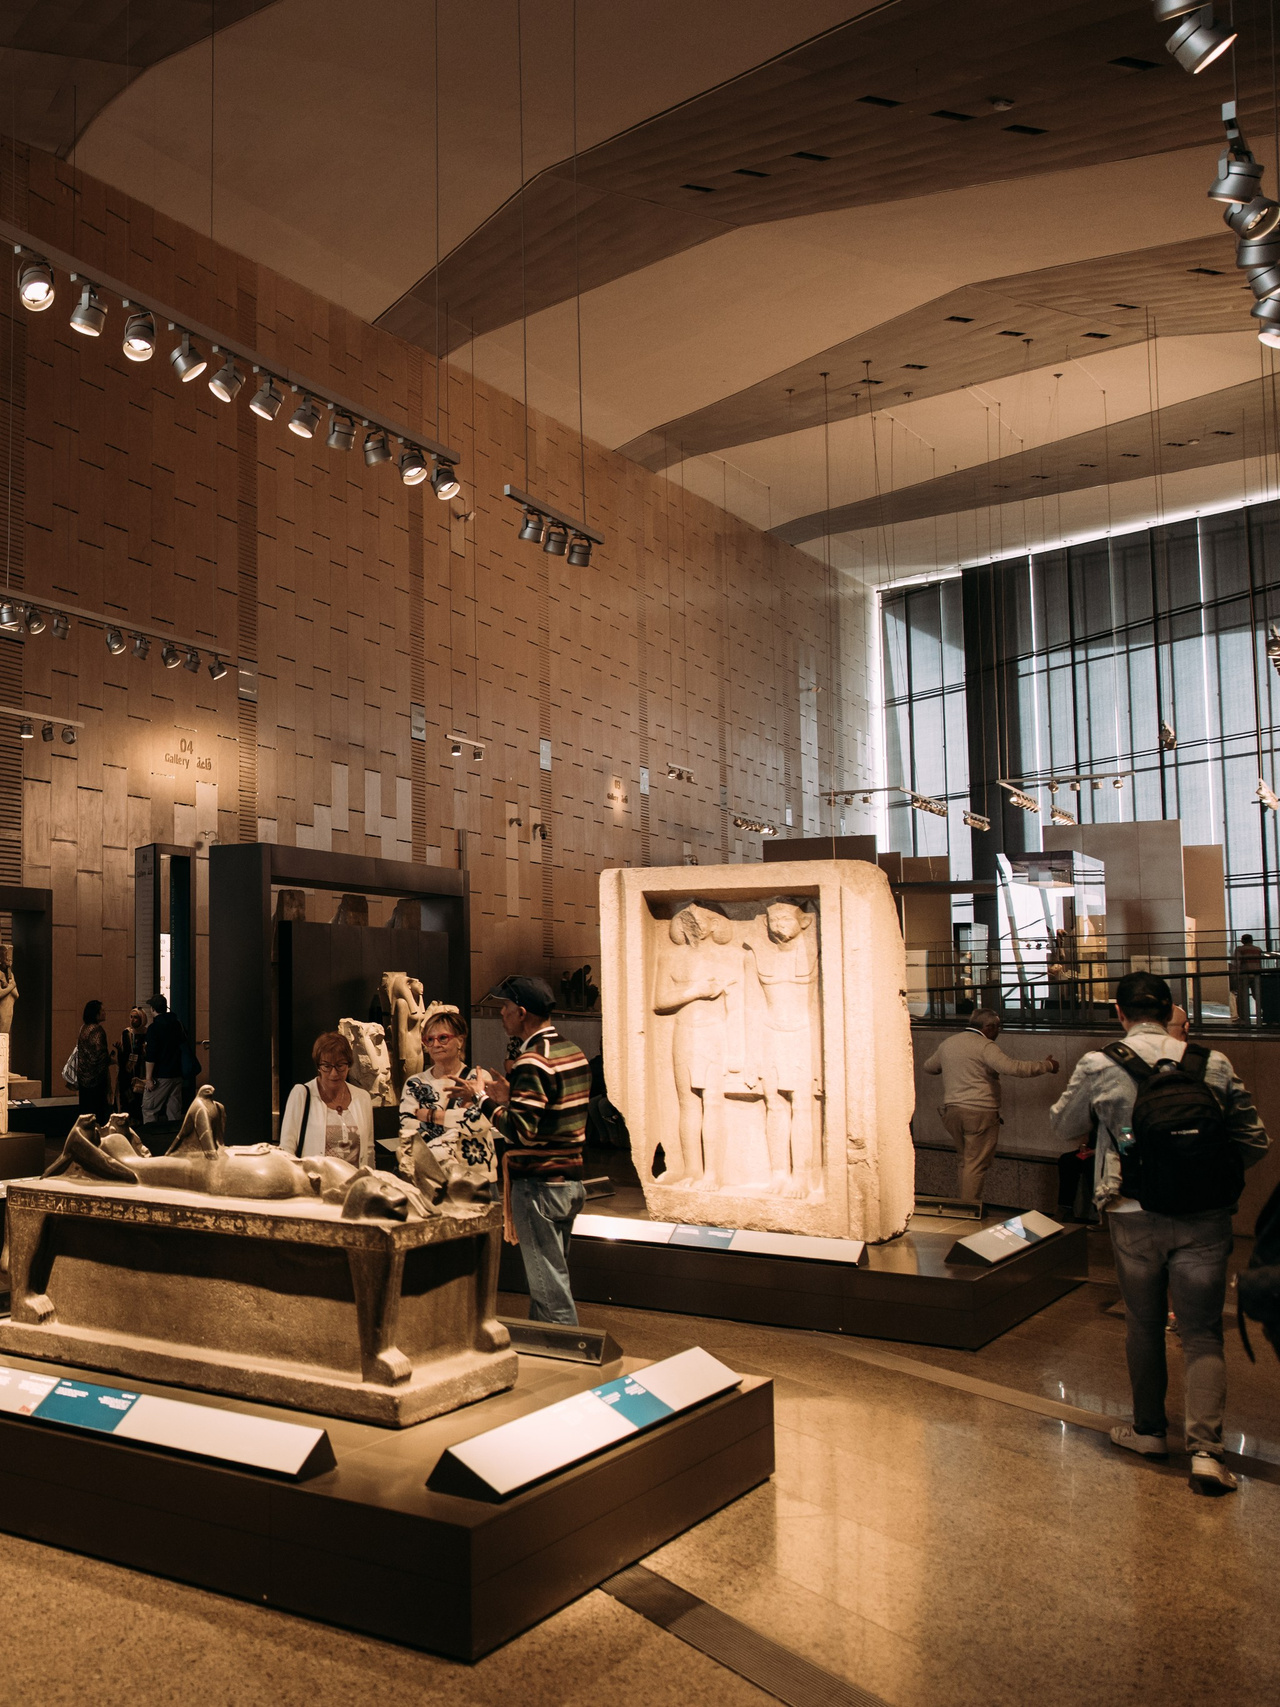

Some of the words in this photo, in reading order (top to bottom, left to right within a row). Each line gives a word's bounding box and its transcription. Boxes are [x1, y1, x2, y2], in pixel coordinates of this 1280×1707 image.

[180, 738, 193, 754] 04
[164, 753, 189, 769] Gallery
[197, 757, 212, 770] قاعة
